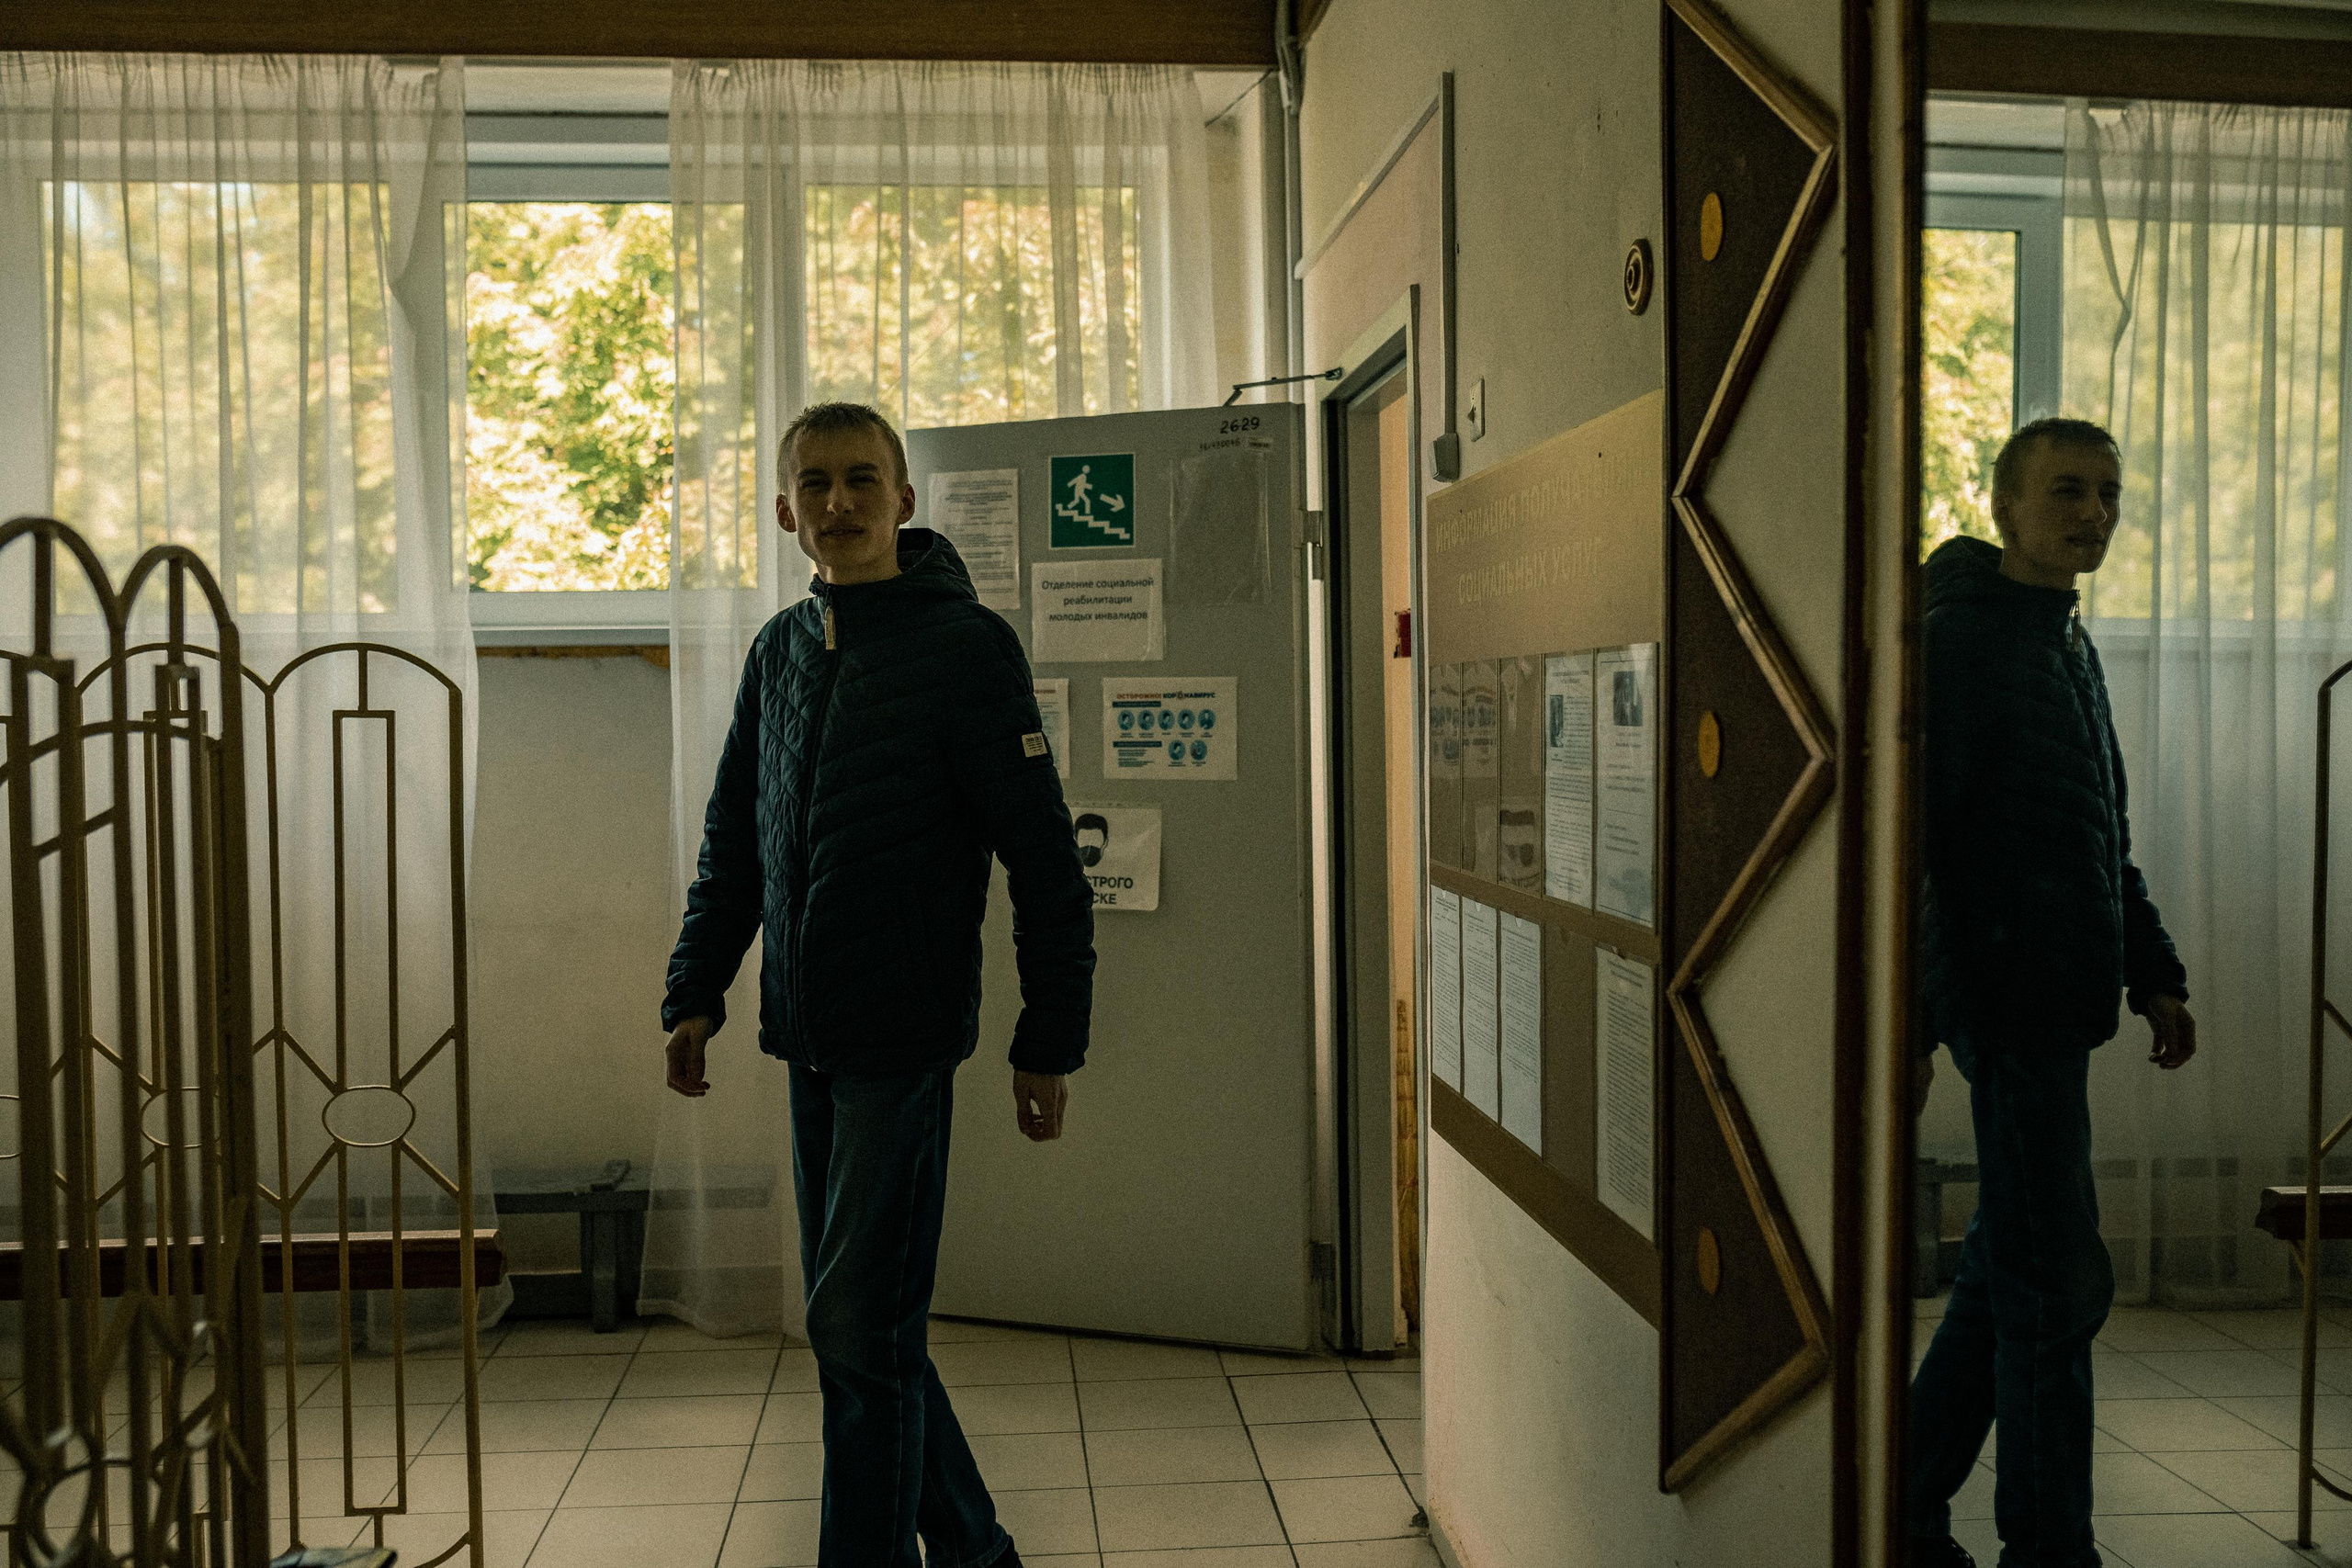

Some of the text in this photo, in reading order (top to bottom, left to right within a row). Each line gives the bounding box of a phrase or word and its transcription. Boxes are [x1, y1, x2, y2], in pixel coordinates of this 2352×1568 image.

[1220, 416, 1261, 434] 2629
[1435, 493, 1517, 553] ИНФОРМАЦИЯ
[1041, 577, 1155, 591] Отделение социальной
[1458, 549, 1547, 607] СОЦИАЛЬНЫХ
[1063, 595, 1133, 606] реабилитации
[1049, 611, 1148, 622] молодых инвалидов
